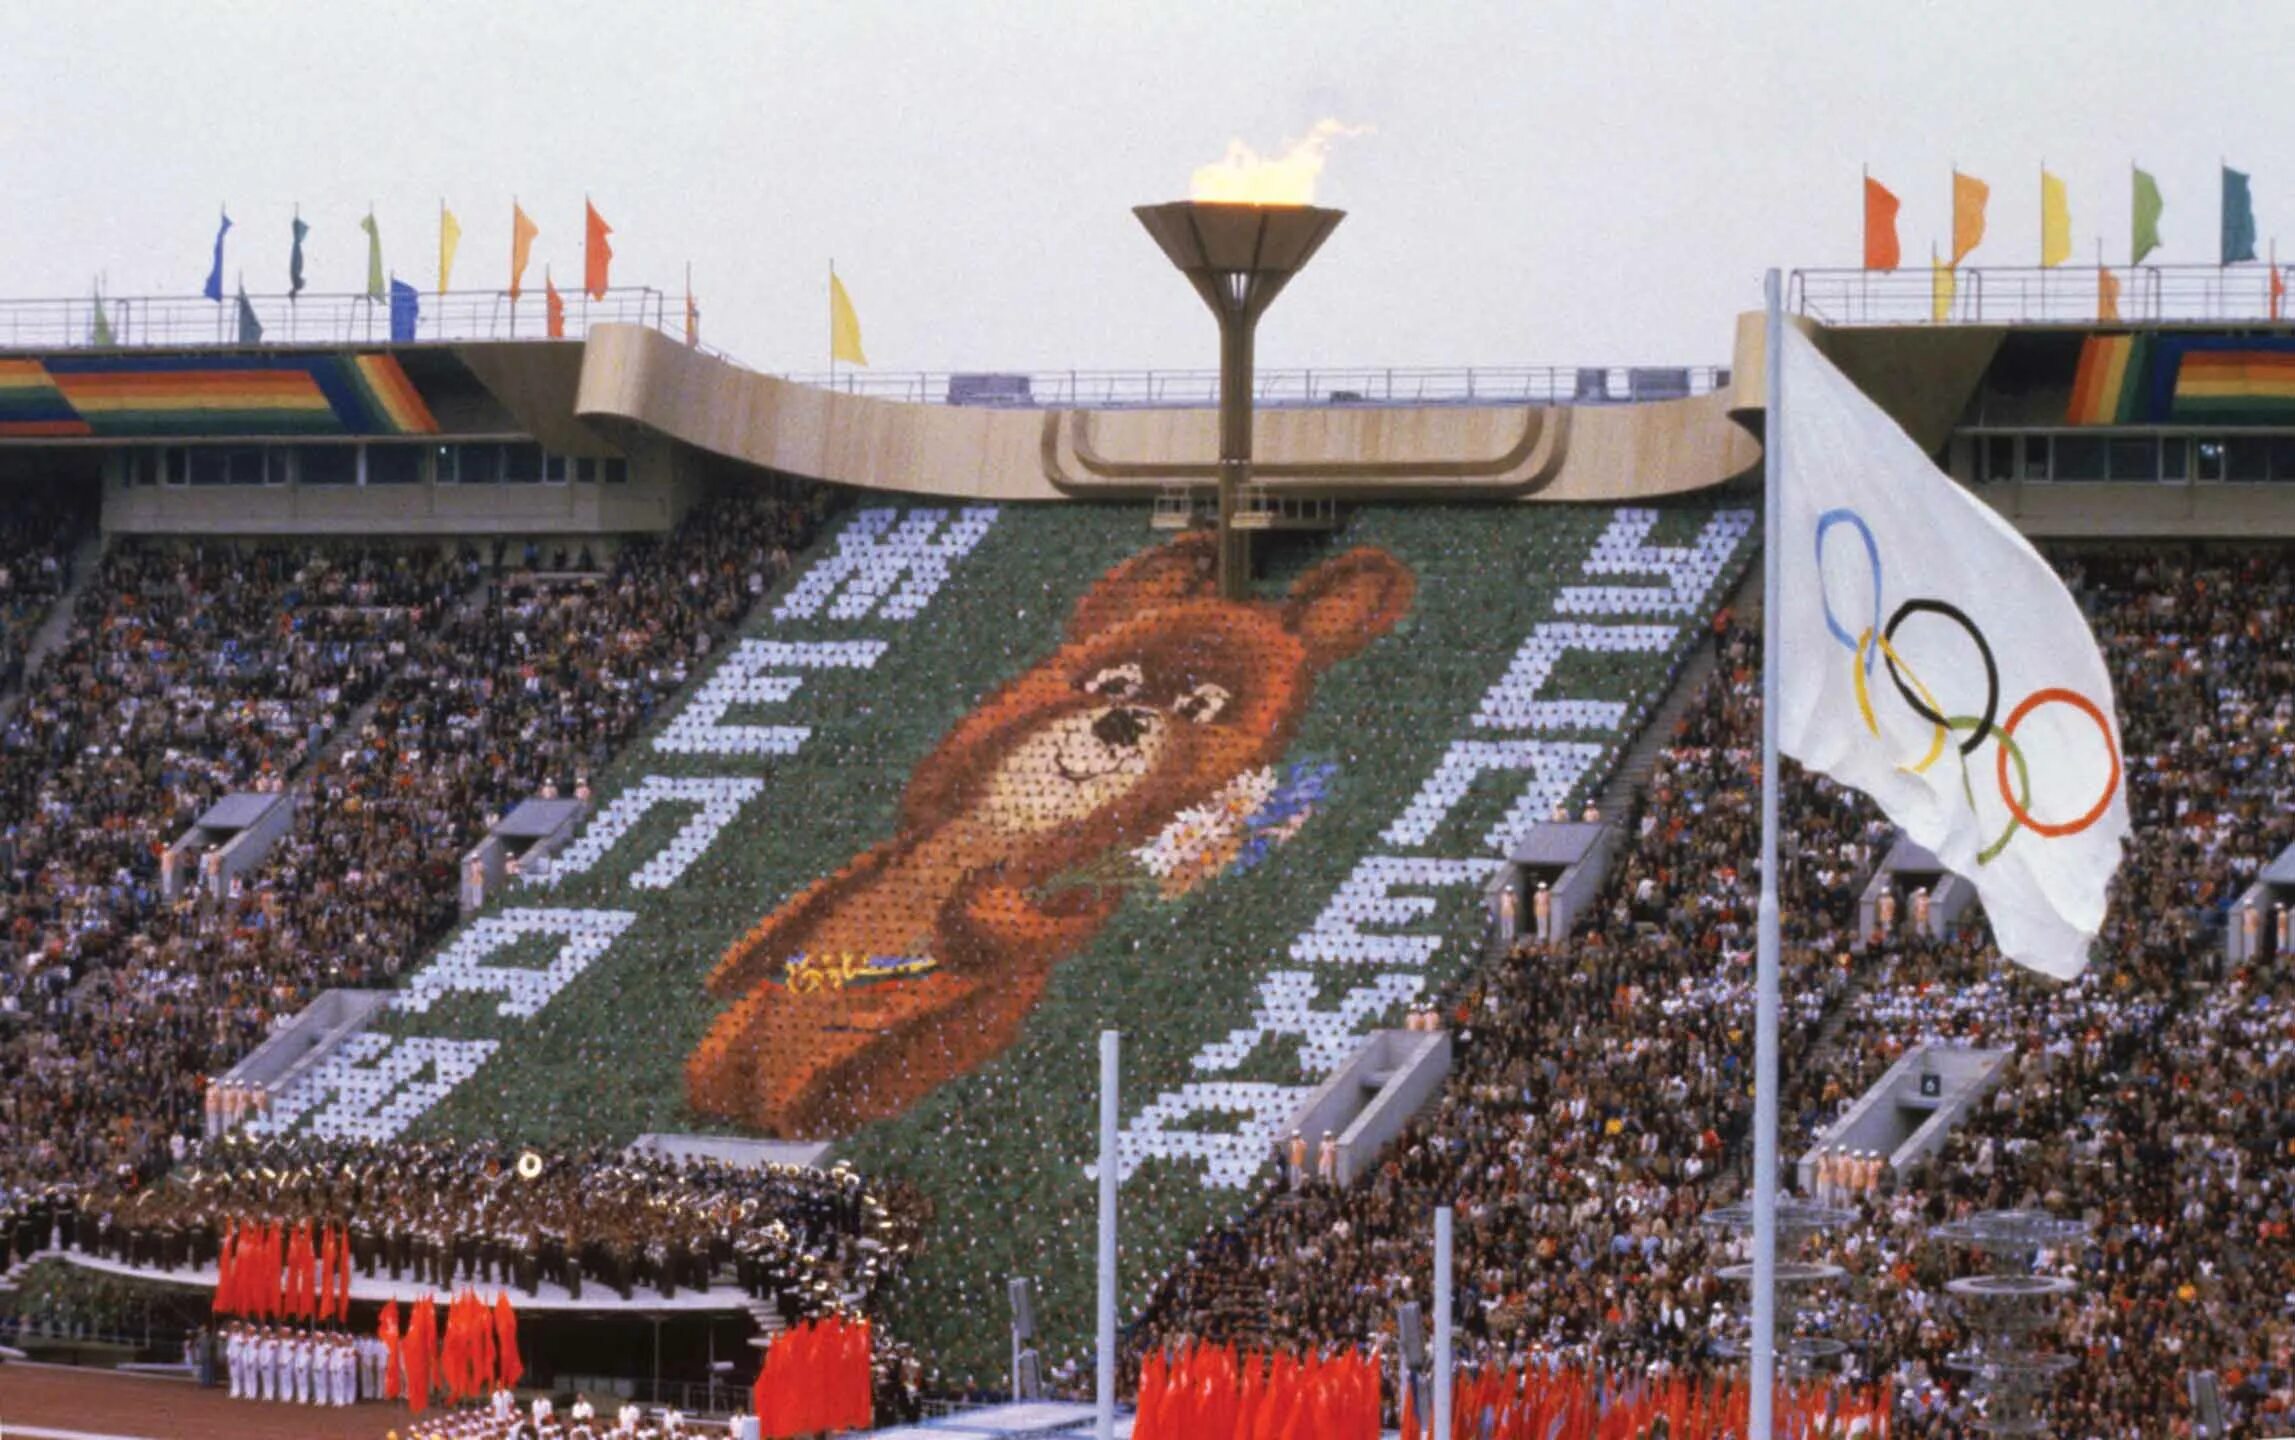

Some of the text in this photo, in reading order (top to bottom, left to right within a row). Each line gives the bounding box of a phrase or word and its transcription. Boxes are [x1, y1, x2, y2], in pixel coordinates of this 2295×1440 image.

[242, 505, 1000, 1141] ЖЕЛАЮ
[1086, 507, 1756, 1190] УСПЕХА
[1926, 1080, 1935, 1092] 6
